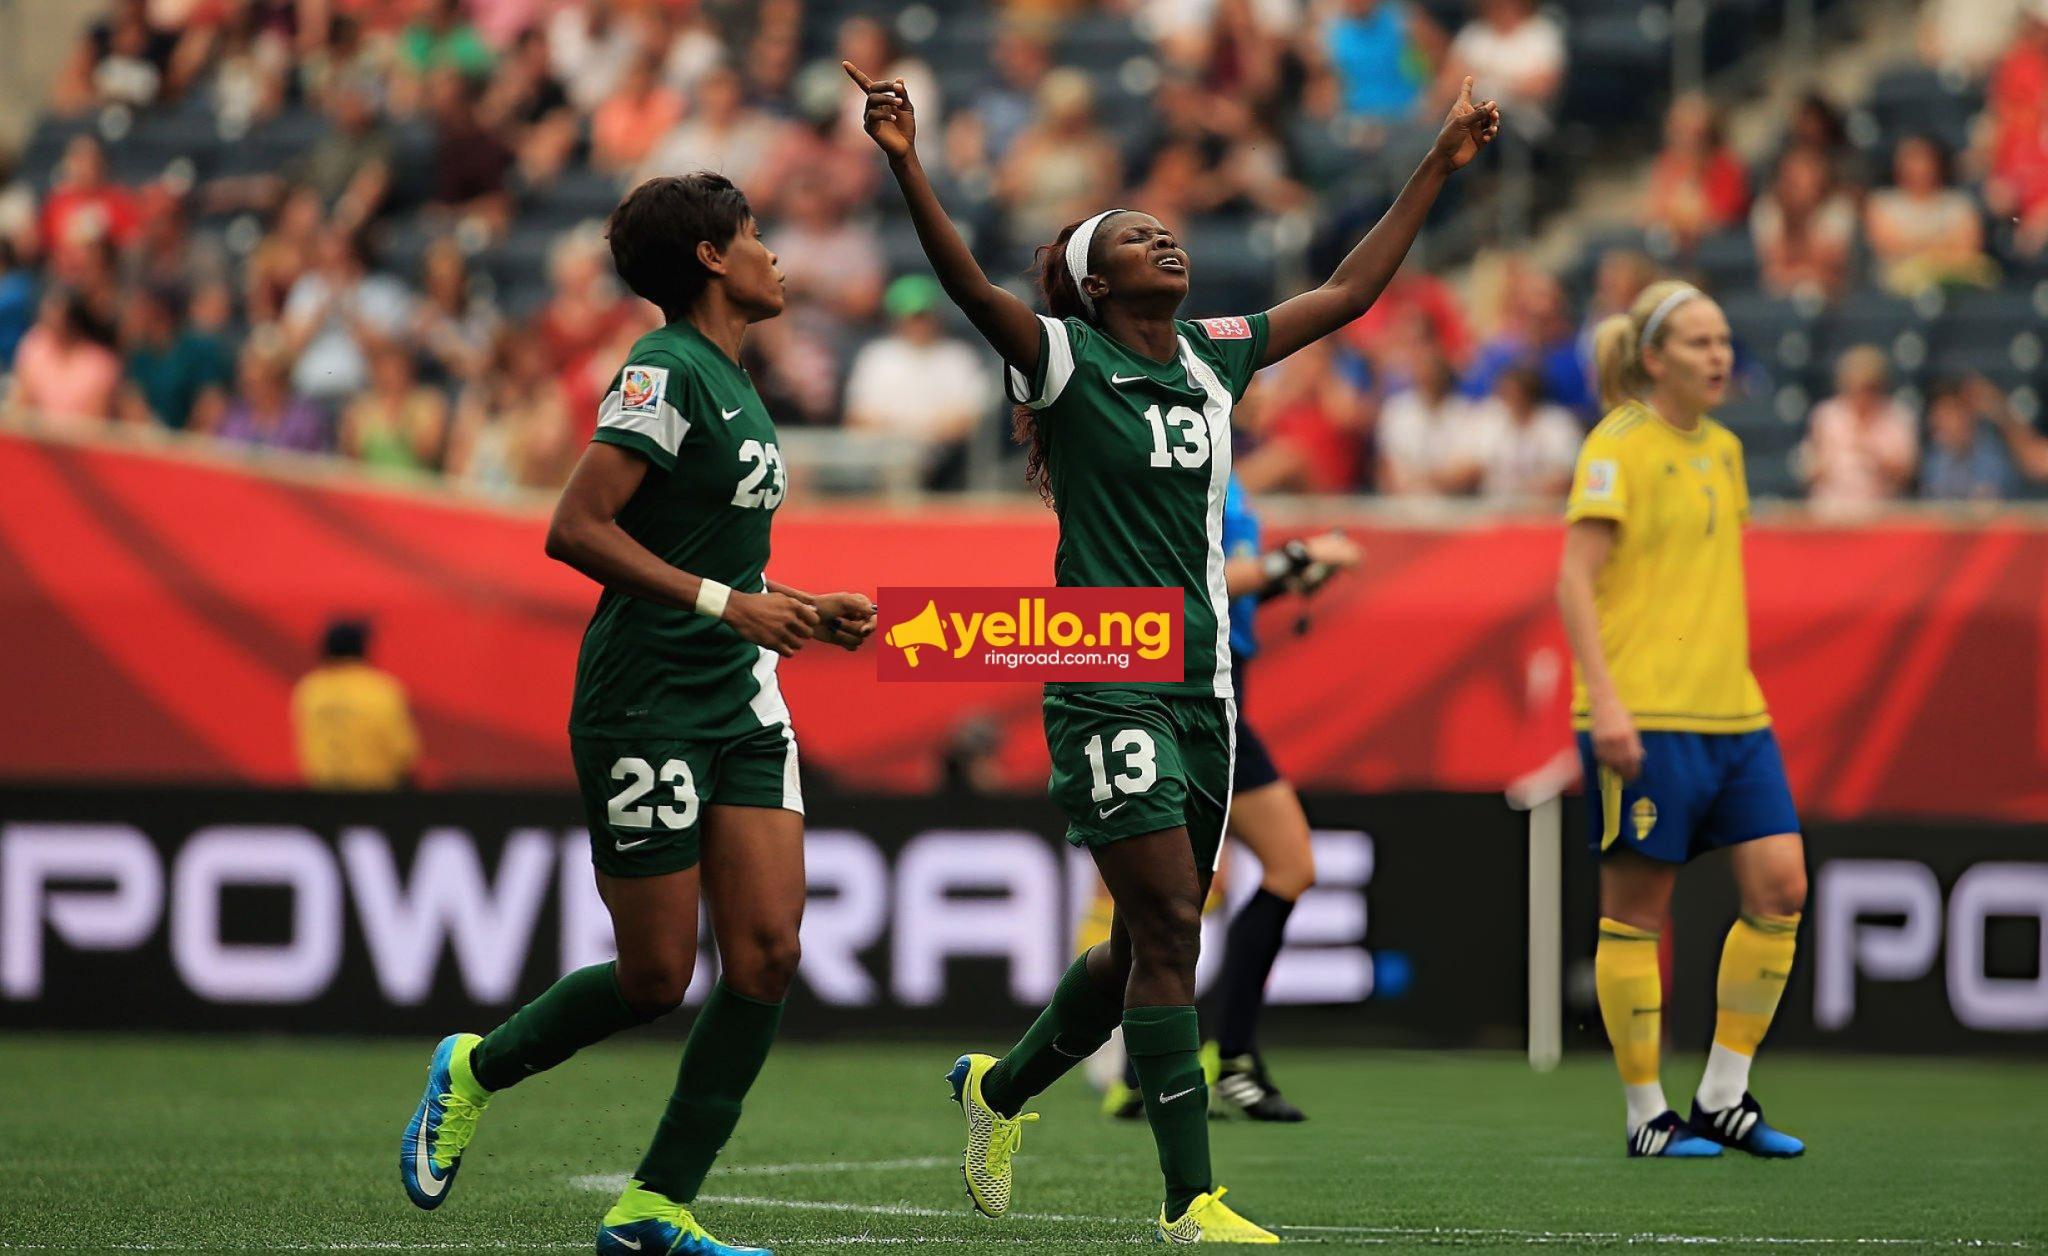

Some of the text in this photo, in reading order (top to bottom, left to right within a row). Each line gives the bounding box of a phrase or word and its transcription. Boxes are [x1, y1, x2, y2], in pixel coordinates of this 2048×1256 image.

[1143, 404, 1210, 468] 13
[731, 439, 784, 509] 23
[607, 757, 700, 829] 23
[1084, 729, 1157, 802] 13
[0, 824, 1375, 1005] POWRAE
